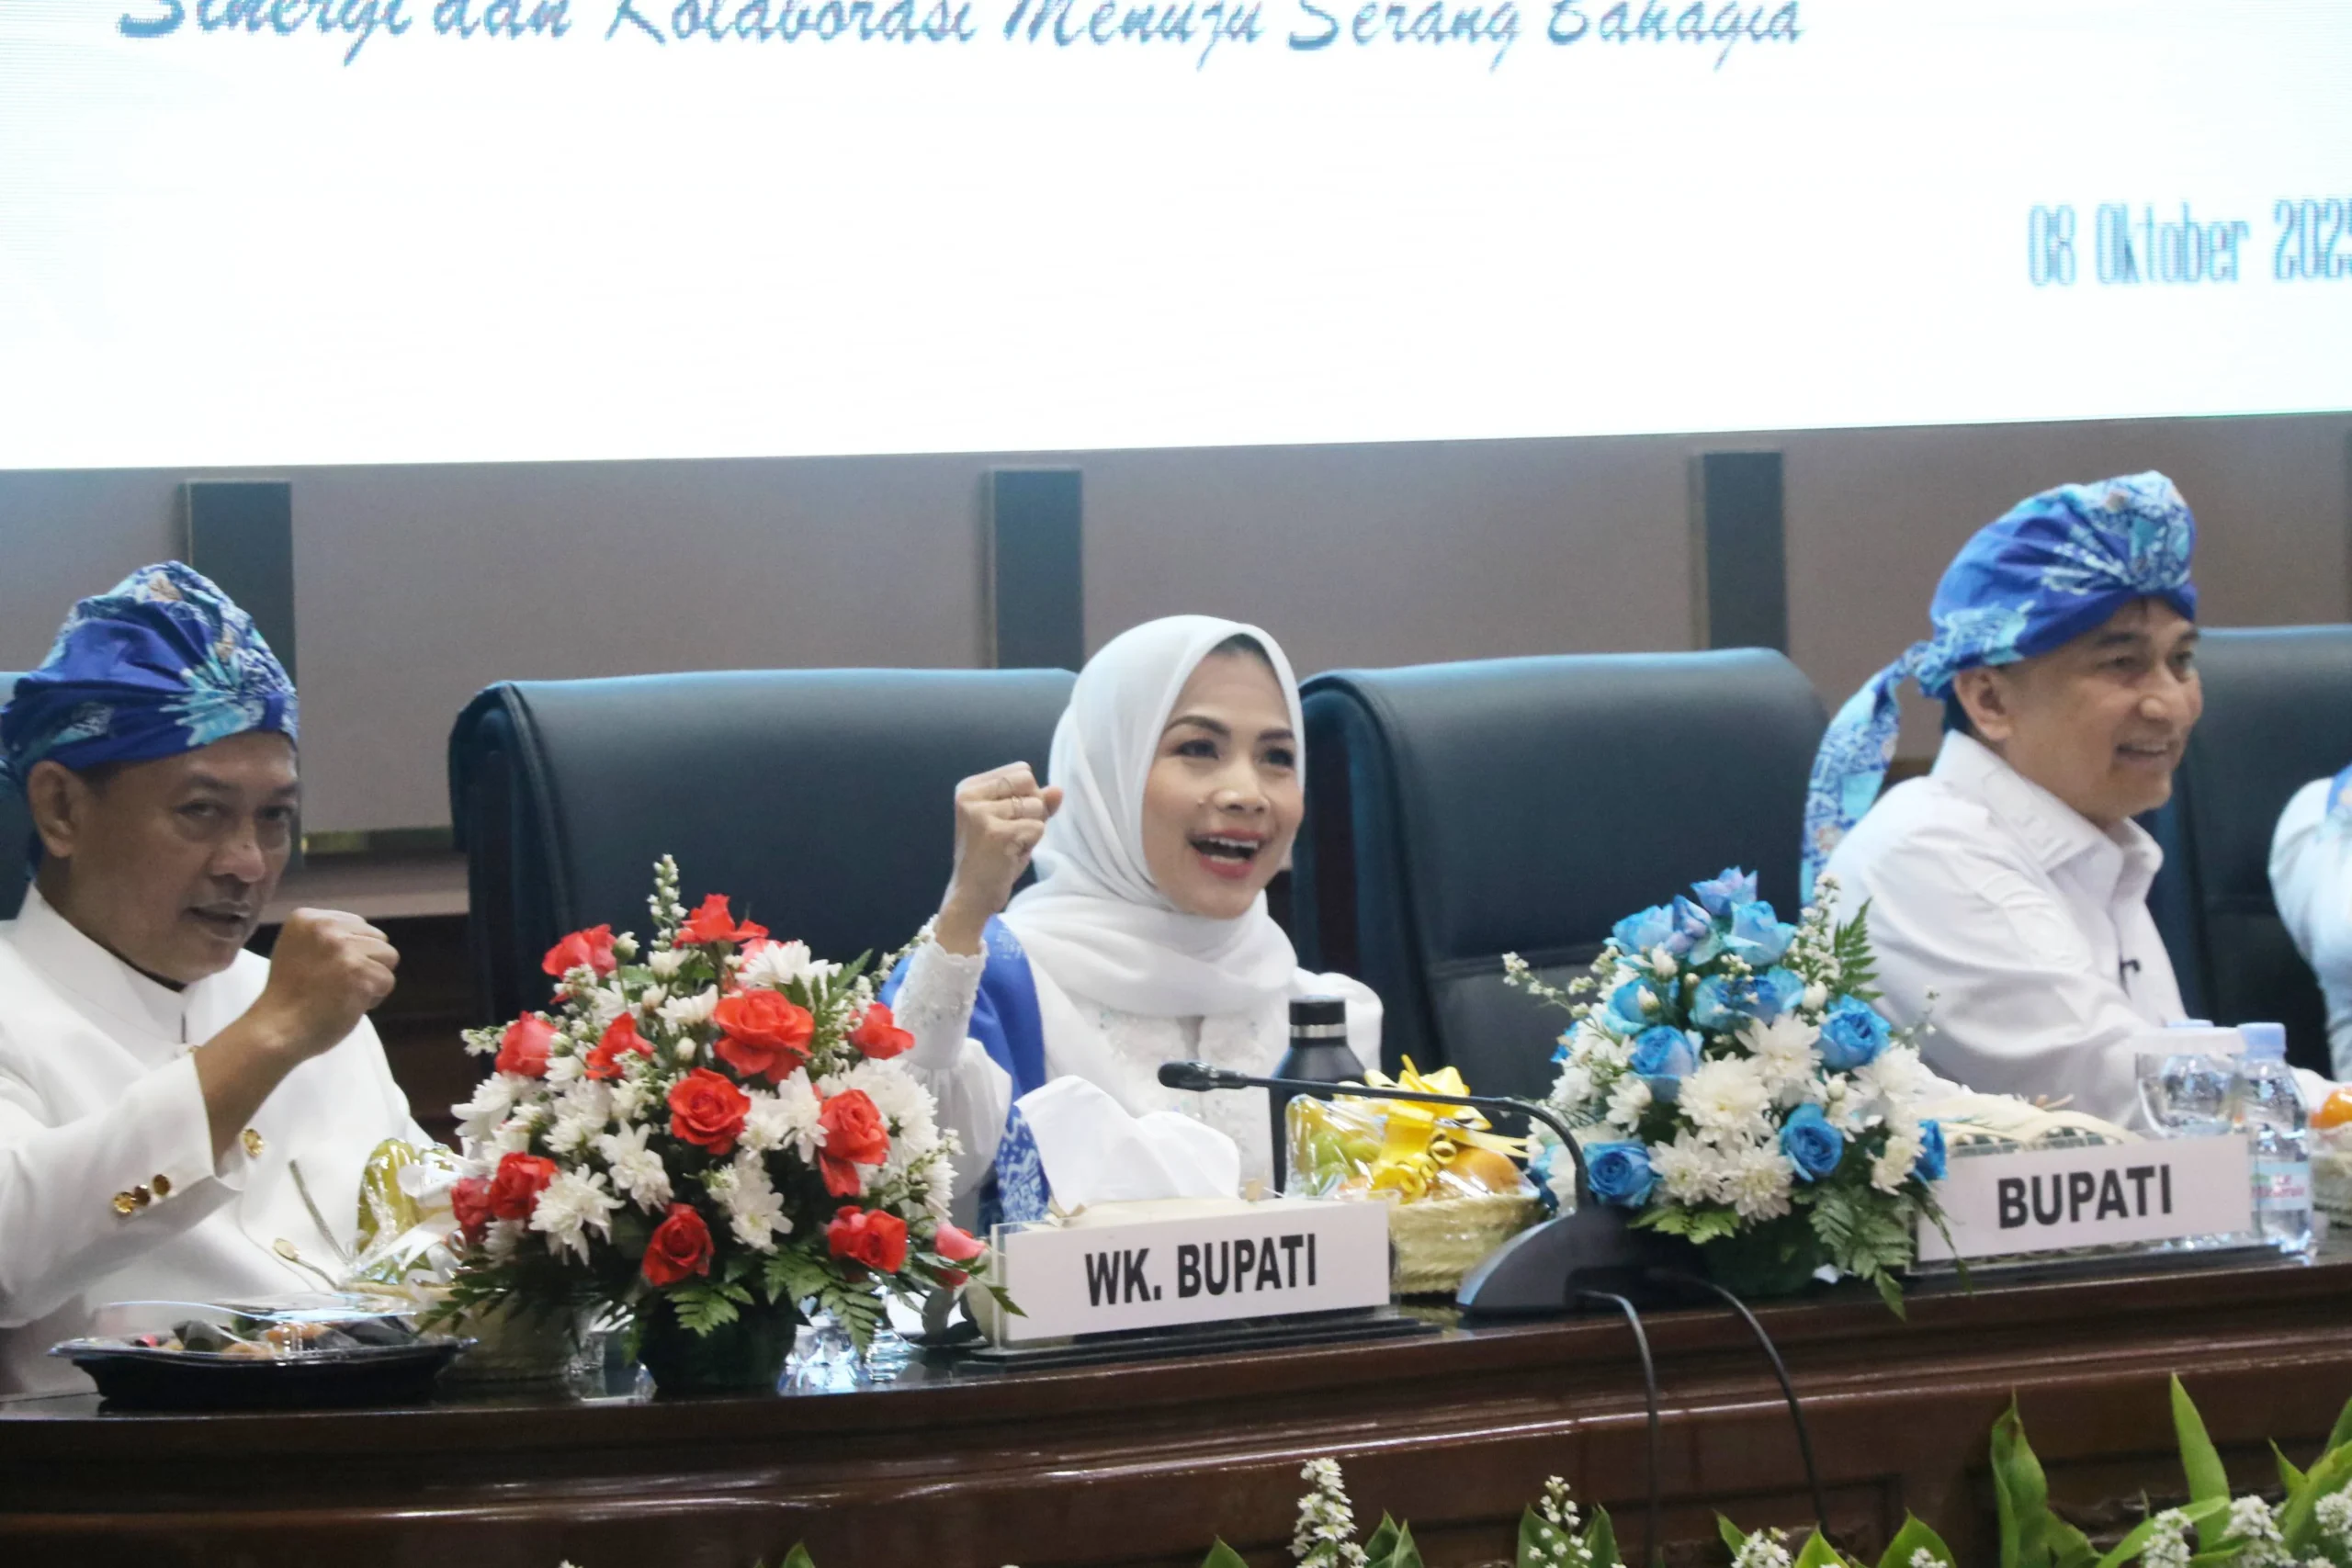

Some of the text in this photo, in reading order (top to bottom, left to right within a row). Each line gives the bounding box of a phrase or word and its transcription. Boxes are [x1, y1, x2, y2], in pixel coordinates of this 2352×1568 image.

[2029, 197, 2352, 286] 08 Oktober 202
[1997, 1164, 2172, 1230] BUPATI
[1085, 1233, 1317, 1307] WK. BUPATI
